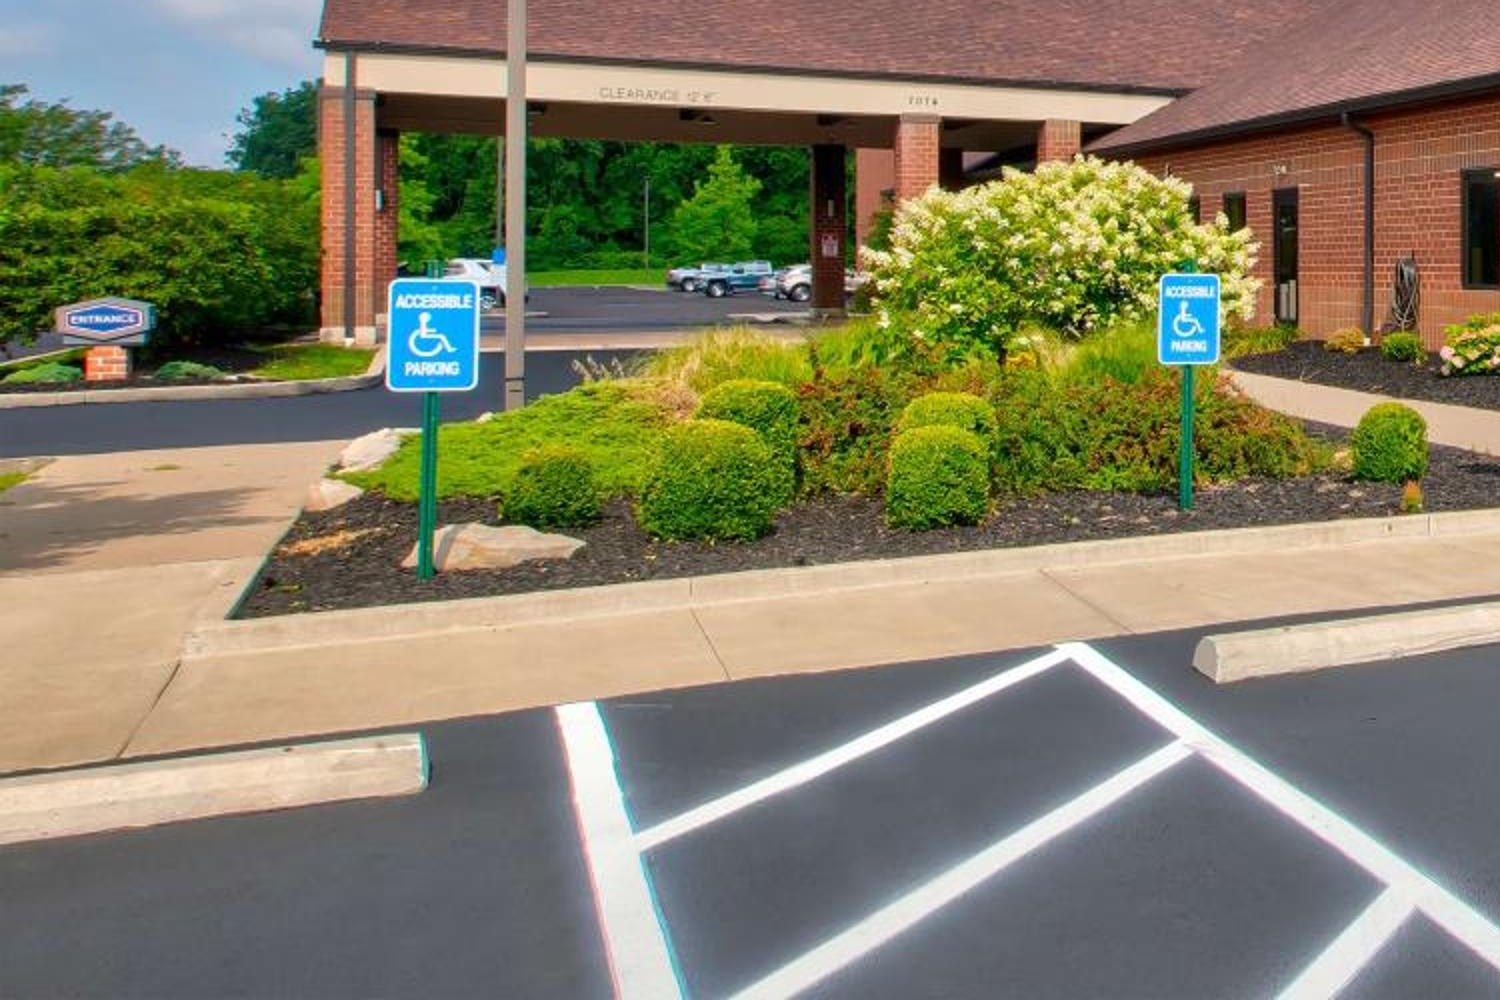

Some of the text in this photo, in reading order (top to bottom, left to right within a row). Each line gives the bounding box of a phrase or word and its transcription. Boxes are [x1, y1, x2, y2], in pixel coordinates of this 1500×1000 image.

[599, 87, 681, 101] CLEARANCE
[1165, 285, 1216, 298] ACCESSIBLE
[395, 293, 473, 309] ACCESSIBLE
[71, 315, 136, 324] ENTRANCE
[1171, 340, 1207, 353] PARKING
[404, 361, 460, 376] PARKING
